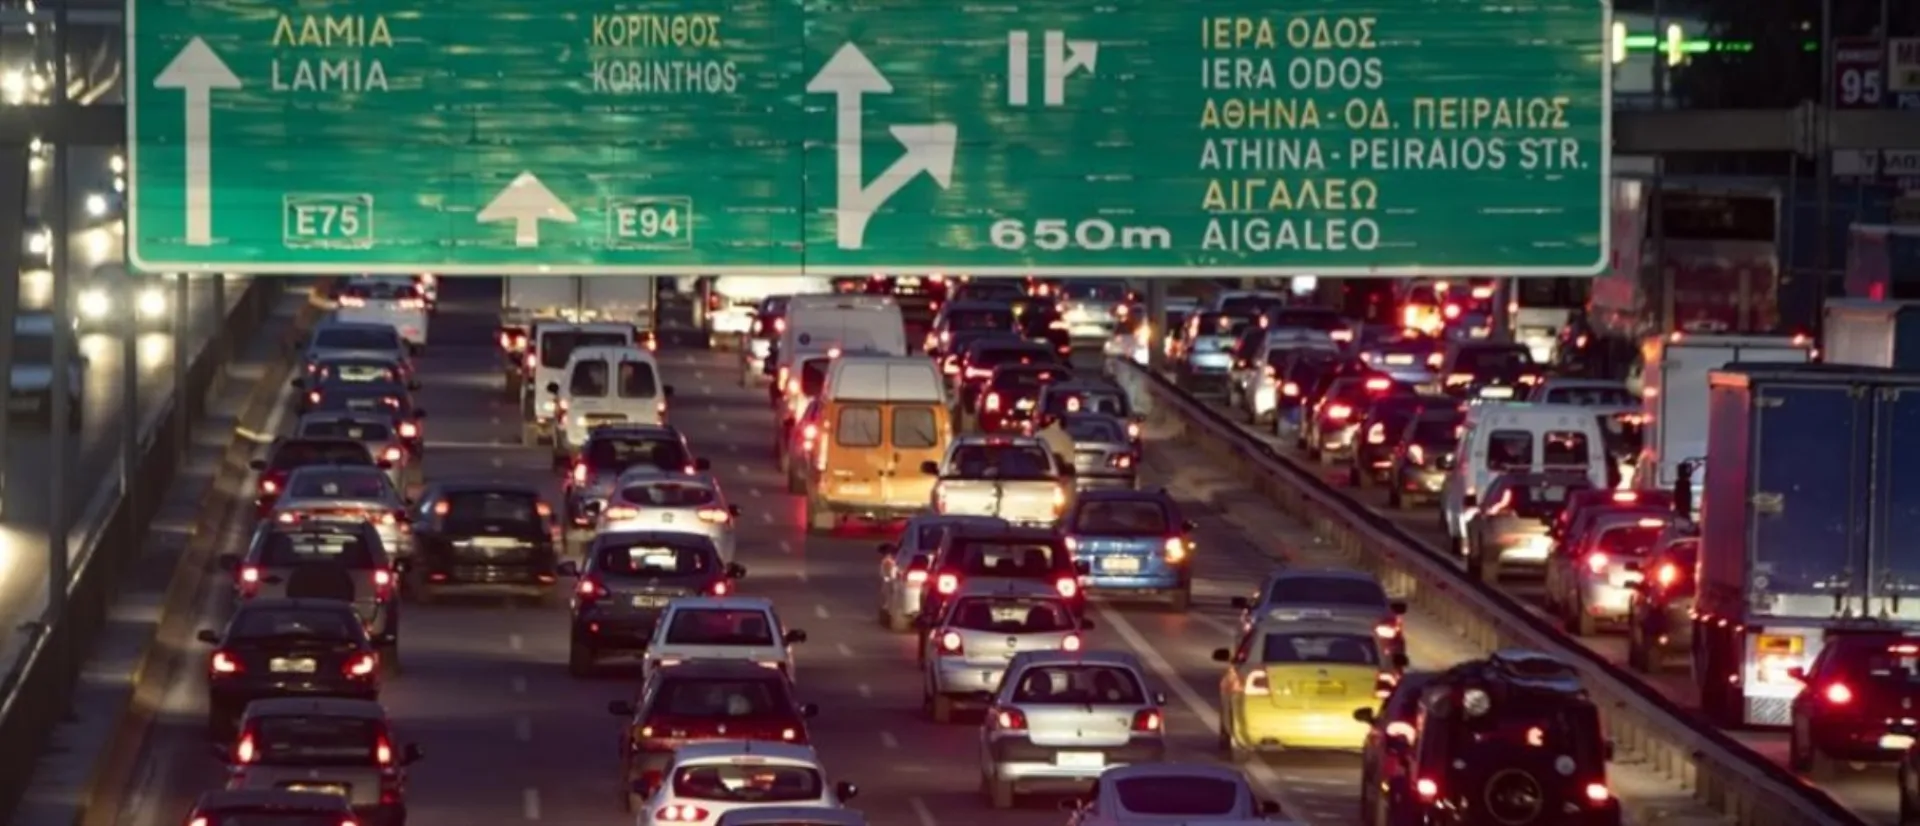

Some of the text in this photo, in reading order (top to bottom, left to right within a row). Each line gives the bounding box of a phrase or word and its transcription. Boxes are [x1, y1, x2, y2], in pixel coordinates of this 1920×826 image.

[272, 14, 394, 47] ΛΑΜΙΑ
[593, 14, 721, 47] ΚΟΡΙΝΘΟΣ
[1202, 16, 1377, 49] ΙΕΡΑ ΟΔΟΣ
[271, 59, 389, 92] LAMIA
[593, 60, 737, 93] KORINTHOS
[1202, 57, 1383, 90] IERA ODOS
[1840, 68, 1880, 104] 95
[1200, 97, 1320, 130] ΑΘΗΝΑ
[1344, 97, 1399, 130] ΟΔ.
[1413, 97, 1570, 130] ΠΕΙΡΑΙΩΣ
[1200, 138, 1325, 170] ATHINA
[1350, 138, 1506, 171] PEIRAIOS
[1519, 138, 1588, 171] STR.
[1202, 178, 1378, 211] ΑΙΓΑΛΕΩ
[296, 205, 359, 237] E75
[617, 207, 680, 238] E94
[989, 218, 1172, 251] 650m
[1202, 217, 1380, 251] AIGALEO
